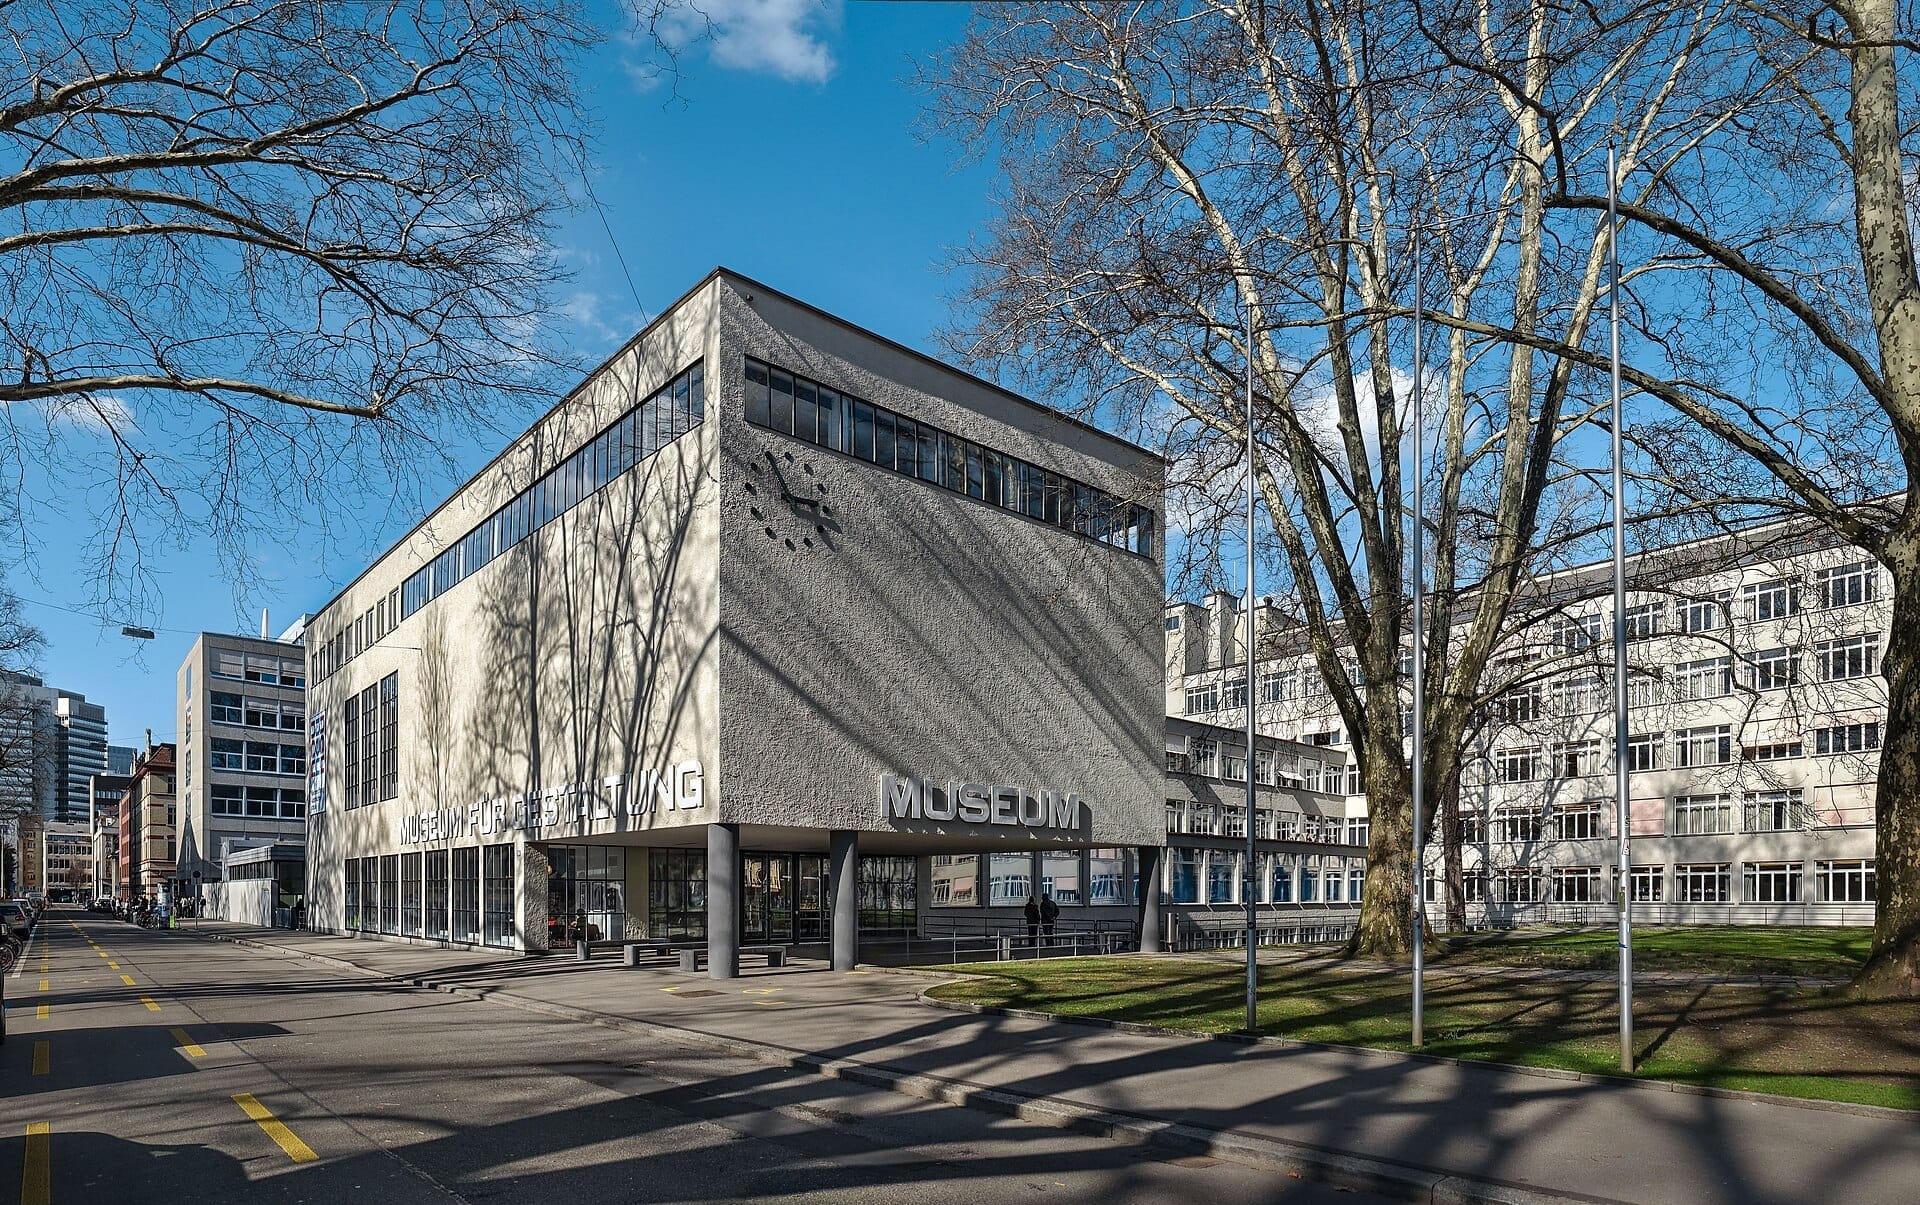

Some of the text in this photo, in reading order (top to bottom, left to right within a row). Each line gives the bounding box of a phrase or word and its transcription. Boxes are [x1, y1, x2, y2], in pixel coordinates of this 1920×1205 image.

[400, 759, 705, 845] MUSEUM FÜR GESTALTUNG
[880, 774, 1080, 830] MUSEUM
